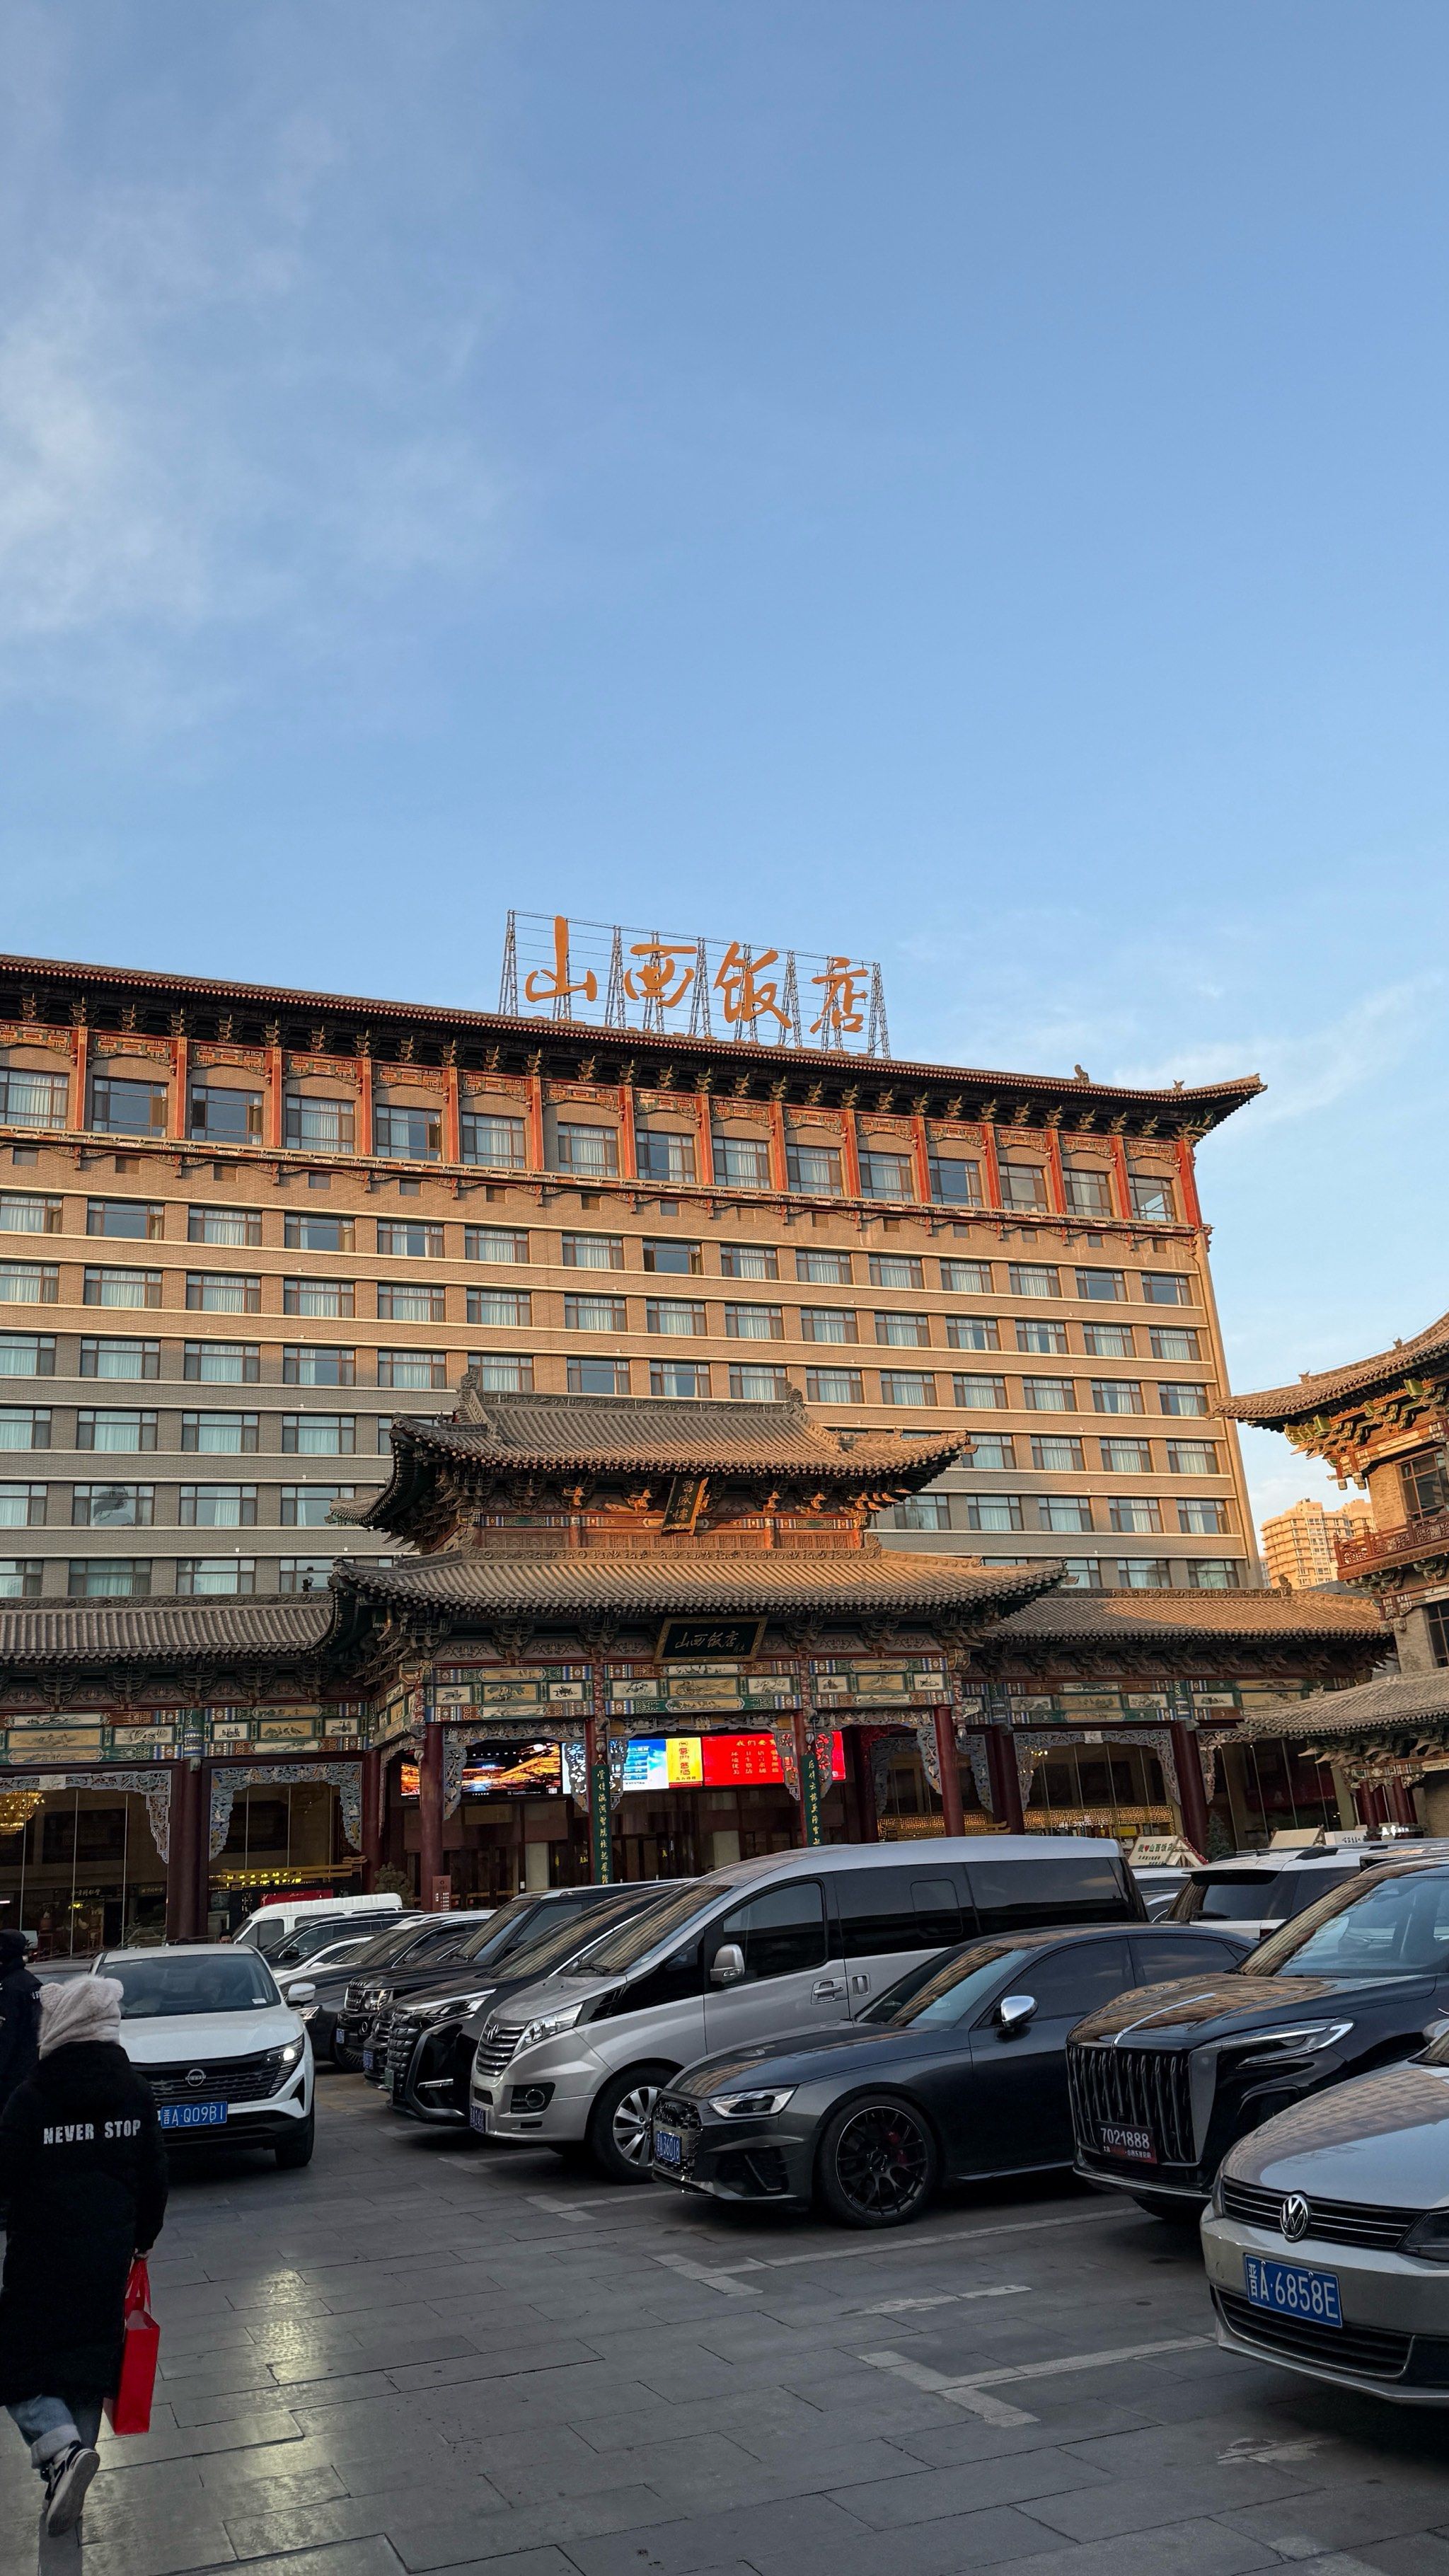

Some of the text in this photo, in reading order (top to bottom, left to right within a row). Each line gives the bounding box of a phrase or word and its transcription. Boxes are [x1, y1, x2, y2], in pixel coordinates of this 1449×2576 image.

[525, 915, 869, 1034] 山西饭店
[675, 1630, 739, 1649] 山西饭店
[43, 2119, 142, 2145] NEVER STOP
[1100, 2127, 1150, 2149] 7021888
